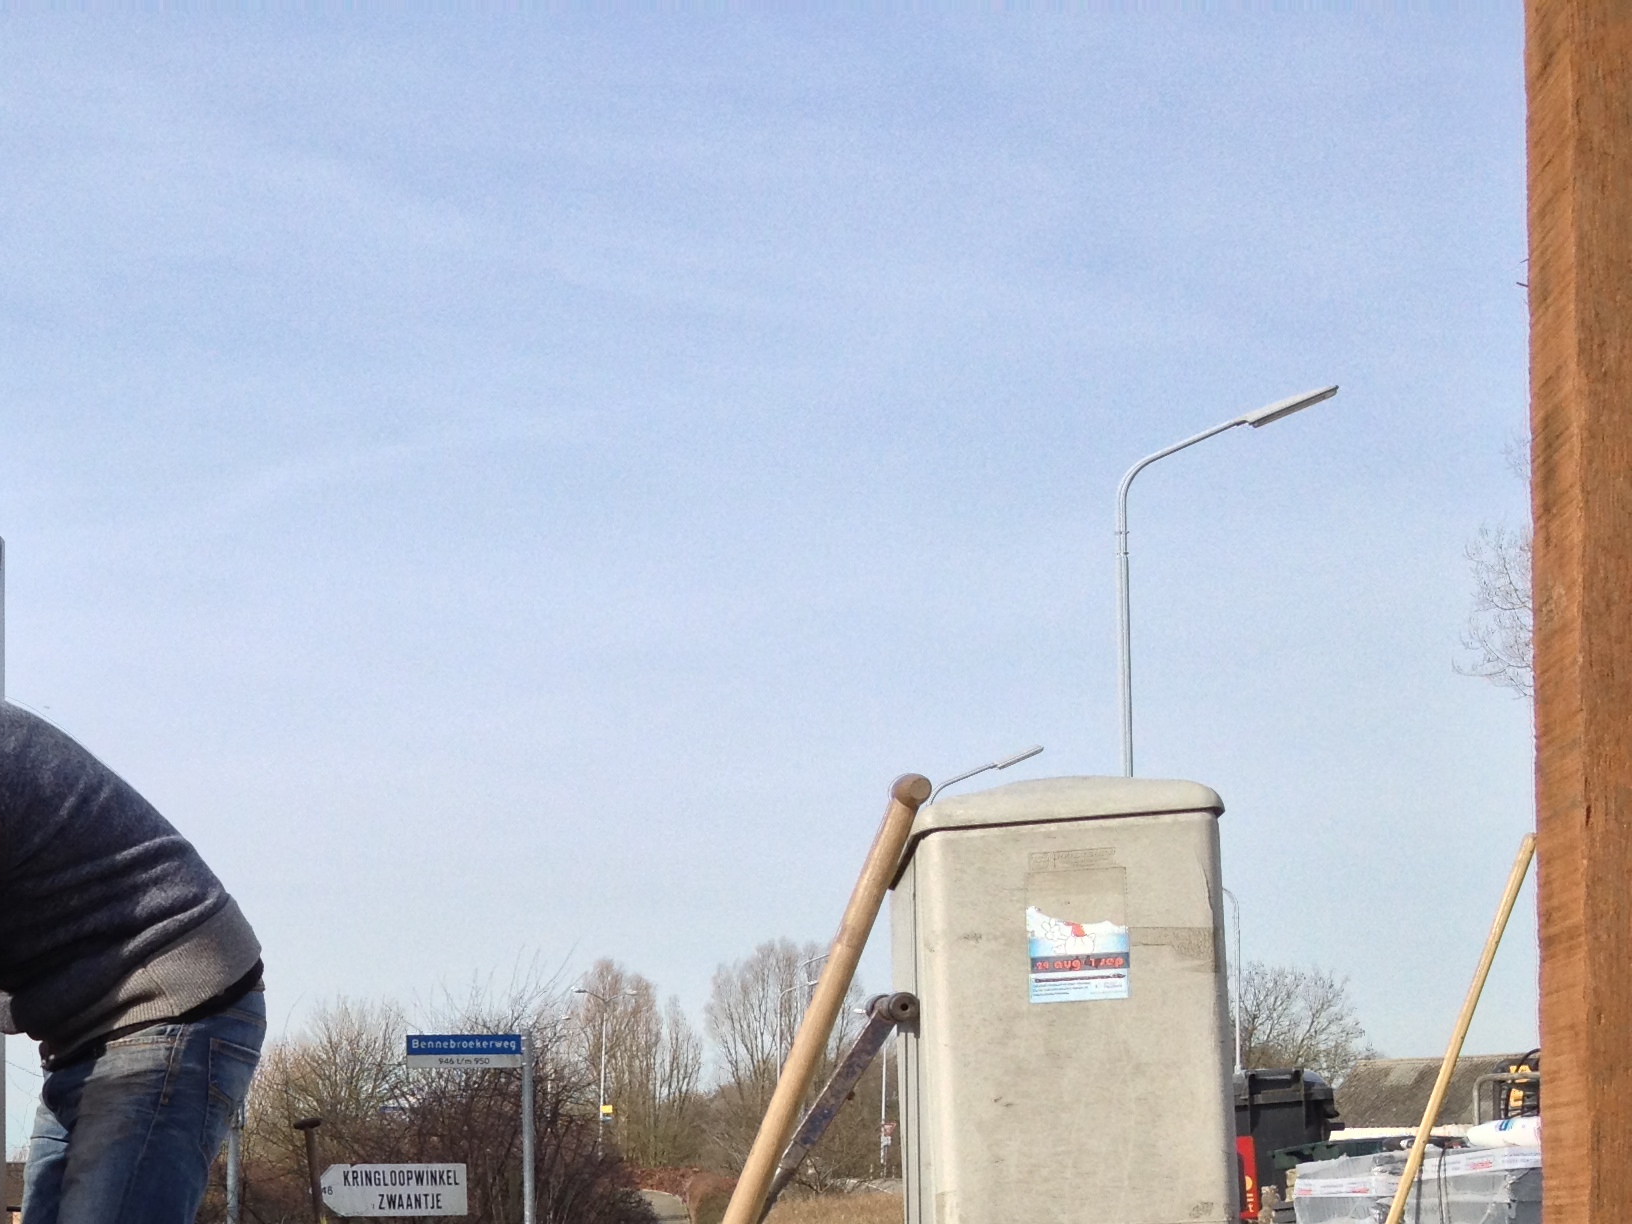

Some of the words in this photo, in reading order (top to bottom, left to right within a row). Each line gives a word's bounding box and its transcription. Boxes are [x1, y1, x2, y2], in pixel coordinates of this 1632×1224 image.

[1053, 959, 1081, 971] aug
[411, 1038, 517, 1051] Bennebroekerweg
[438, 1057, 455, 1065] 946
[456, 1057, 472, 1065] t/m
[473, 1057, 490, 1065] 950
[342, 1169, 460, 1187] KRINGLOOPWINKEL
[377, 1192, 443, 1210] ZWAANTJE
